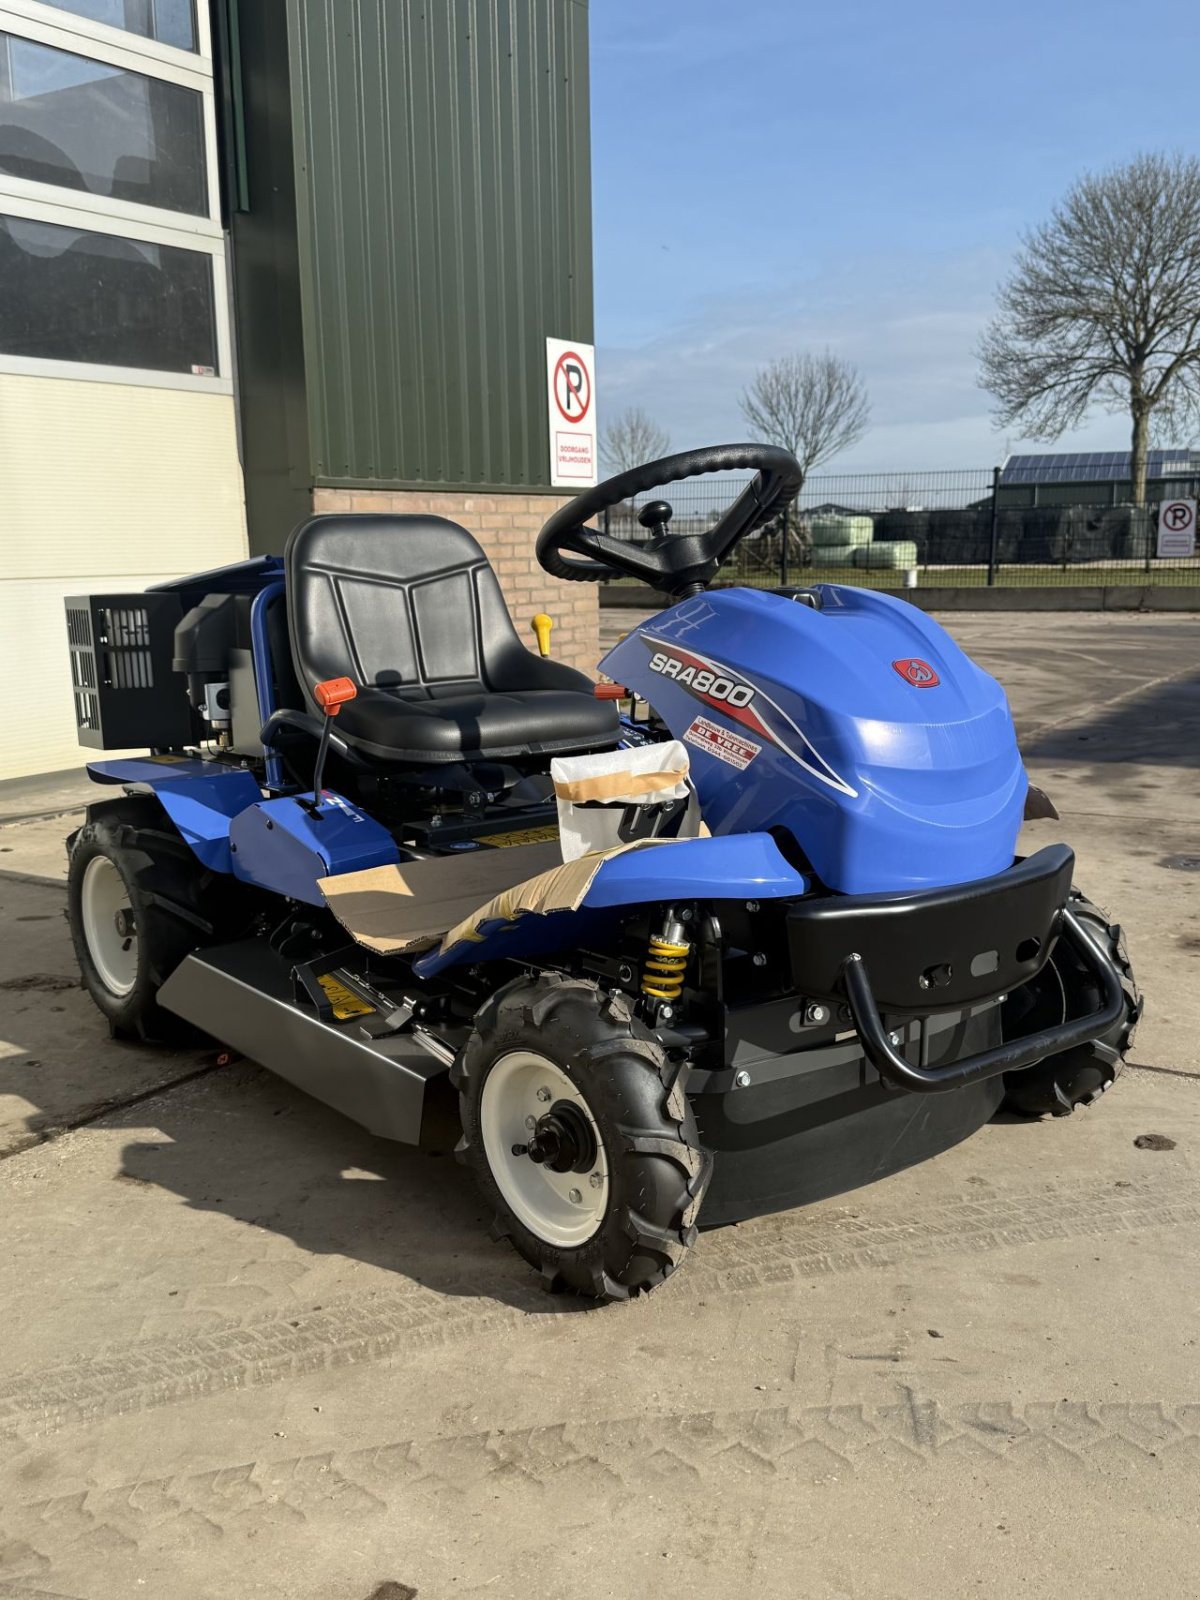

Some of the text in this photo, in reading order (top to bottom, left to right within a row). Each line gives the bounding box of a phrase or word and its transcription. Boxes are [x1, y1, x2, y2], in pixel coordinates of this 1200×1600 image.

[649, 653, 755, 708] SRA800
[697, 727, 712, 739] DE
[717, 736, 747, 755] VREE
